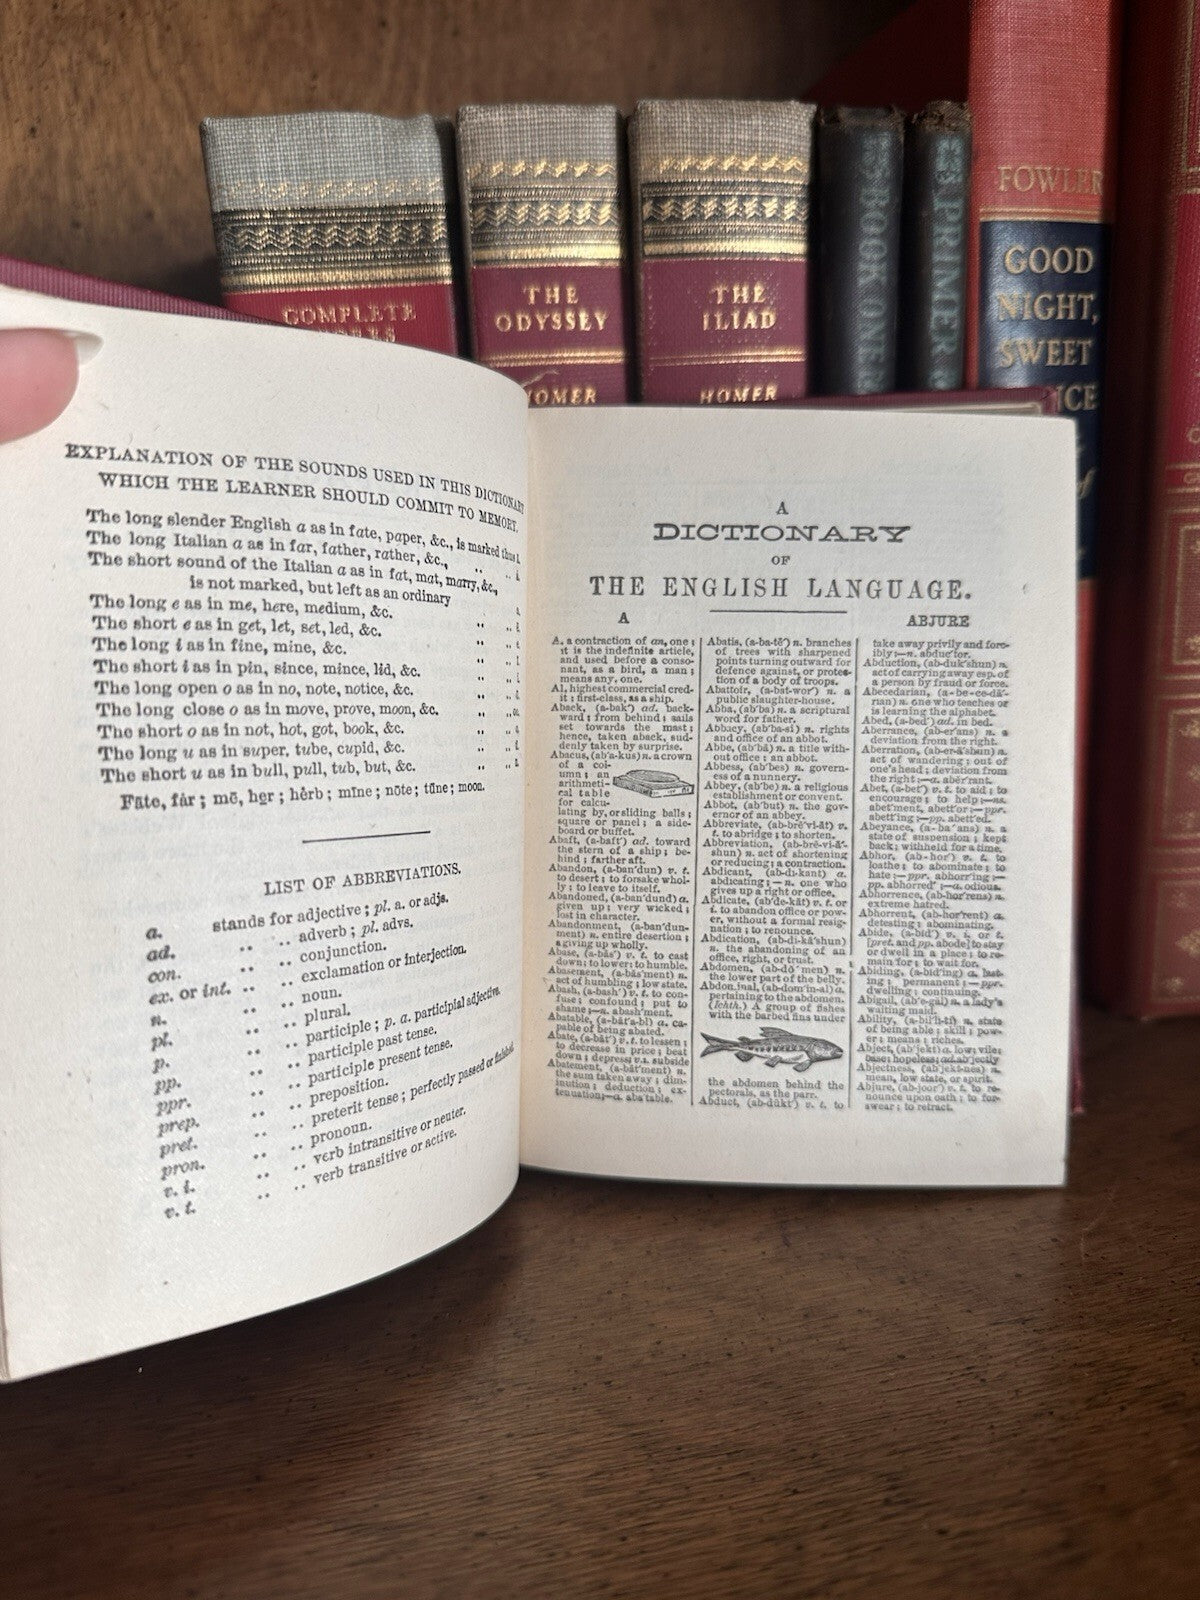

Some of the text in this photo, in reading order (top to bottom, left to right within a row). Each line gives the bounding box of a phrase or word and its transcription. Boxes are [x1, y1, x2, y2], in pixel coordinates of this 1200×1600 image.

[998, 166, 1103, 194] FOWLER
[1005, 246, 1094, 274] GOOD
[522, 285, 578, 305] THE
[709, 282, 766, 304] THE
[277, 302, 416, 325] COMPLETE
[495, 308, 608, 332] ODYSSEY
[703, 308, 777, 331] ILIAD
[999, 339, 1092, 368] SWEET
[700, 384, 777, 404] HOMER
[65, 443, 213, 466] EXPLANATION
[221, 454, 247, 468] OF
[254, 456, 294, 472] THE
[299, 460, 368, 480] SOUNDS
[372, 468, 414, 486] USED
[419, 474, 436, 490] IN
[440, 478, 471, 497] THIS
[98, 471, 520, 533] WHICH THE LEARNER SHOULD COMMIT TO MEMORY.
[775, 501, 789, 515] A
[85, 508, 121, 524] The
[125, 510, 163, 529] long
[167, 512, 226, 528] slender
[230, 515, 291, 534] English
[296, 522, 307, 533] a
[310, 523, 327, 535] as
[329, 522, 345, 536] in
[349, 524, 382, 543] fate,
[385, 531, 426, 548] paper,
[429, 532, 454, 552] &c.,
[455, 536, 467, 551] is
[467, 542, 501, 559] marked
[653, 522, 911, 544] DICTIONARY
[771, 555, 791, 566] OF
[189, 574, 451, 608] is not marked, but left as an ordinary
[589, 575, 972, 600] THE ENGLISH LANGUAGE.
[91, 615, 128, 630] The
[133, 615, 178, 630] short
[195, 620, 213, 631] as
[216, 617, 233, 631] in
[238, 619, 267, 635] get,
[271, 618, 295, 636] let,
[301, 622, 326, 637] set,
[329, 621, 354, 638] led,
[358, 623, 382, 637] &c.
[617, 611, 630, 624] A
[906, 614, 970, 628] ABJURE
[91, 636, 127, 652] The
[131, 636, 170, 654] long
[186, 641, 205, 652] as
[208, 637, 225, 652] in
[230, 638, 268, 656] fine,
[273, 642, 316, 656] mine,
[322, 640, 347, 655] &c.
[714, 646, 851, 659] of trees with sharpened
[94, 680, 414, 698] The long open o as in no, note, notice, &c.
[880, 679, 915, 688] person
[918, 678, 932, 689] by
[933, 678, 963, 688] fraud
[964, 680, 977, 688] or
[978, 678, 1009, 688] force.
[713, 713, 796, 725] word for father.
[871, 706, 997, 720] is learning the alphabet.
[558, 740, 684, 754] denly taken by surprise.
[558, 825, 635, 836] board or buffet.
[264, 862, 462, 896] LIST OF ABBREVIATIONS.
[147, 940, 387, 984] con. conjunction.
[708, 952, 814, 965] office, right, or trust.
[179, 988, 198, 1000] or
[202, 981, 232, 998] int.
[301, 960, 385, 983] exclamation
[386, 957, 403, 970] or
[403, 943, 468, 968] interjection.
[301, 989, 342, 1004] noun.
[708, 1009, 846, 1023] with the barbed fins under
[153, 1024, 439, 1096] pp. participle past tense.
[707, 1076, 844, 1090] the abdomen behind the
[158, 1078, 389, 1138] prep. preposition.
[160, 1121, 372, 1181] pron. pronoun.
[313, 1166, 344, 1184] verb
[348, 1148, 407, 1175] transitive
[409, 1140, 424, 1155] or
[423, 1127, 459, 1149] active.
